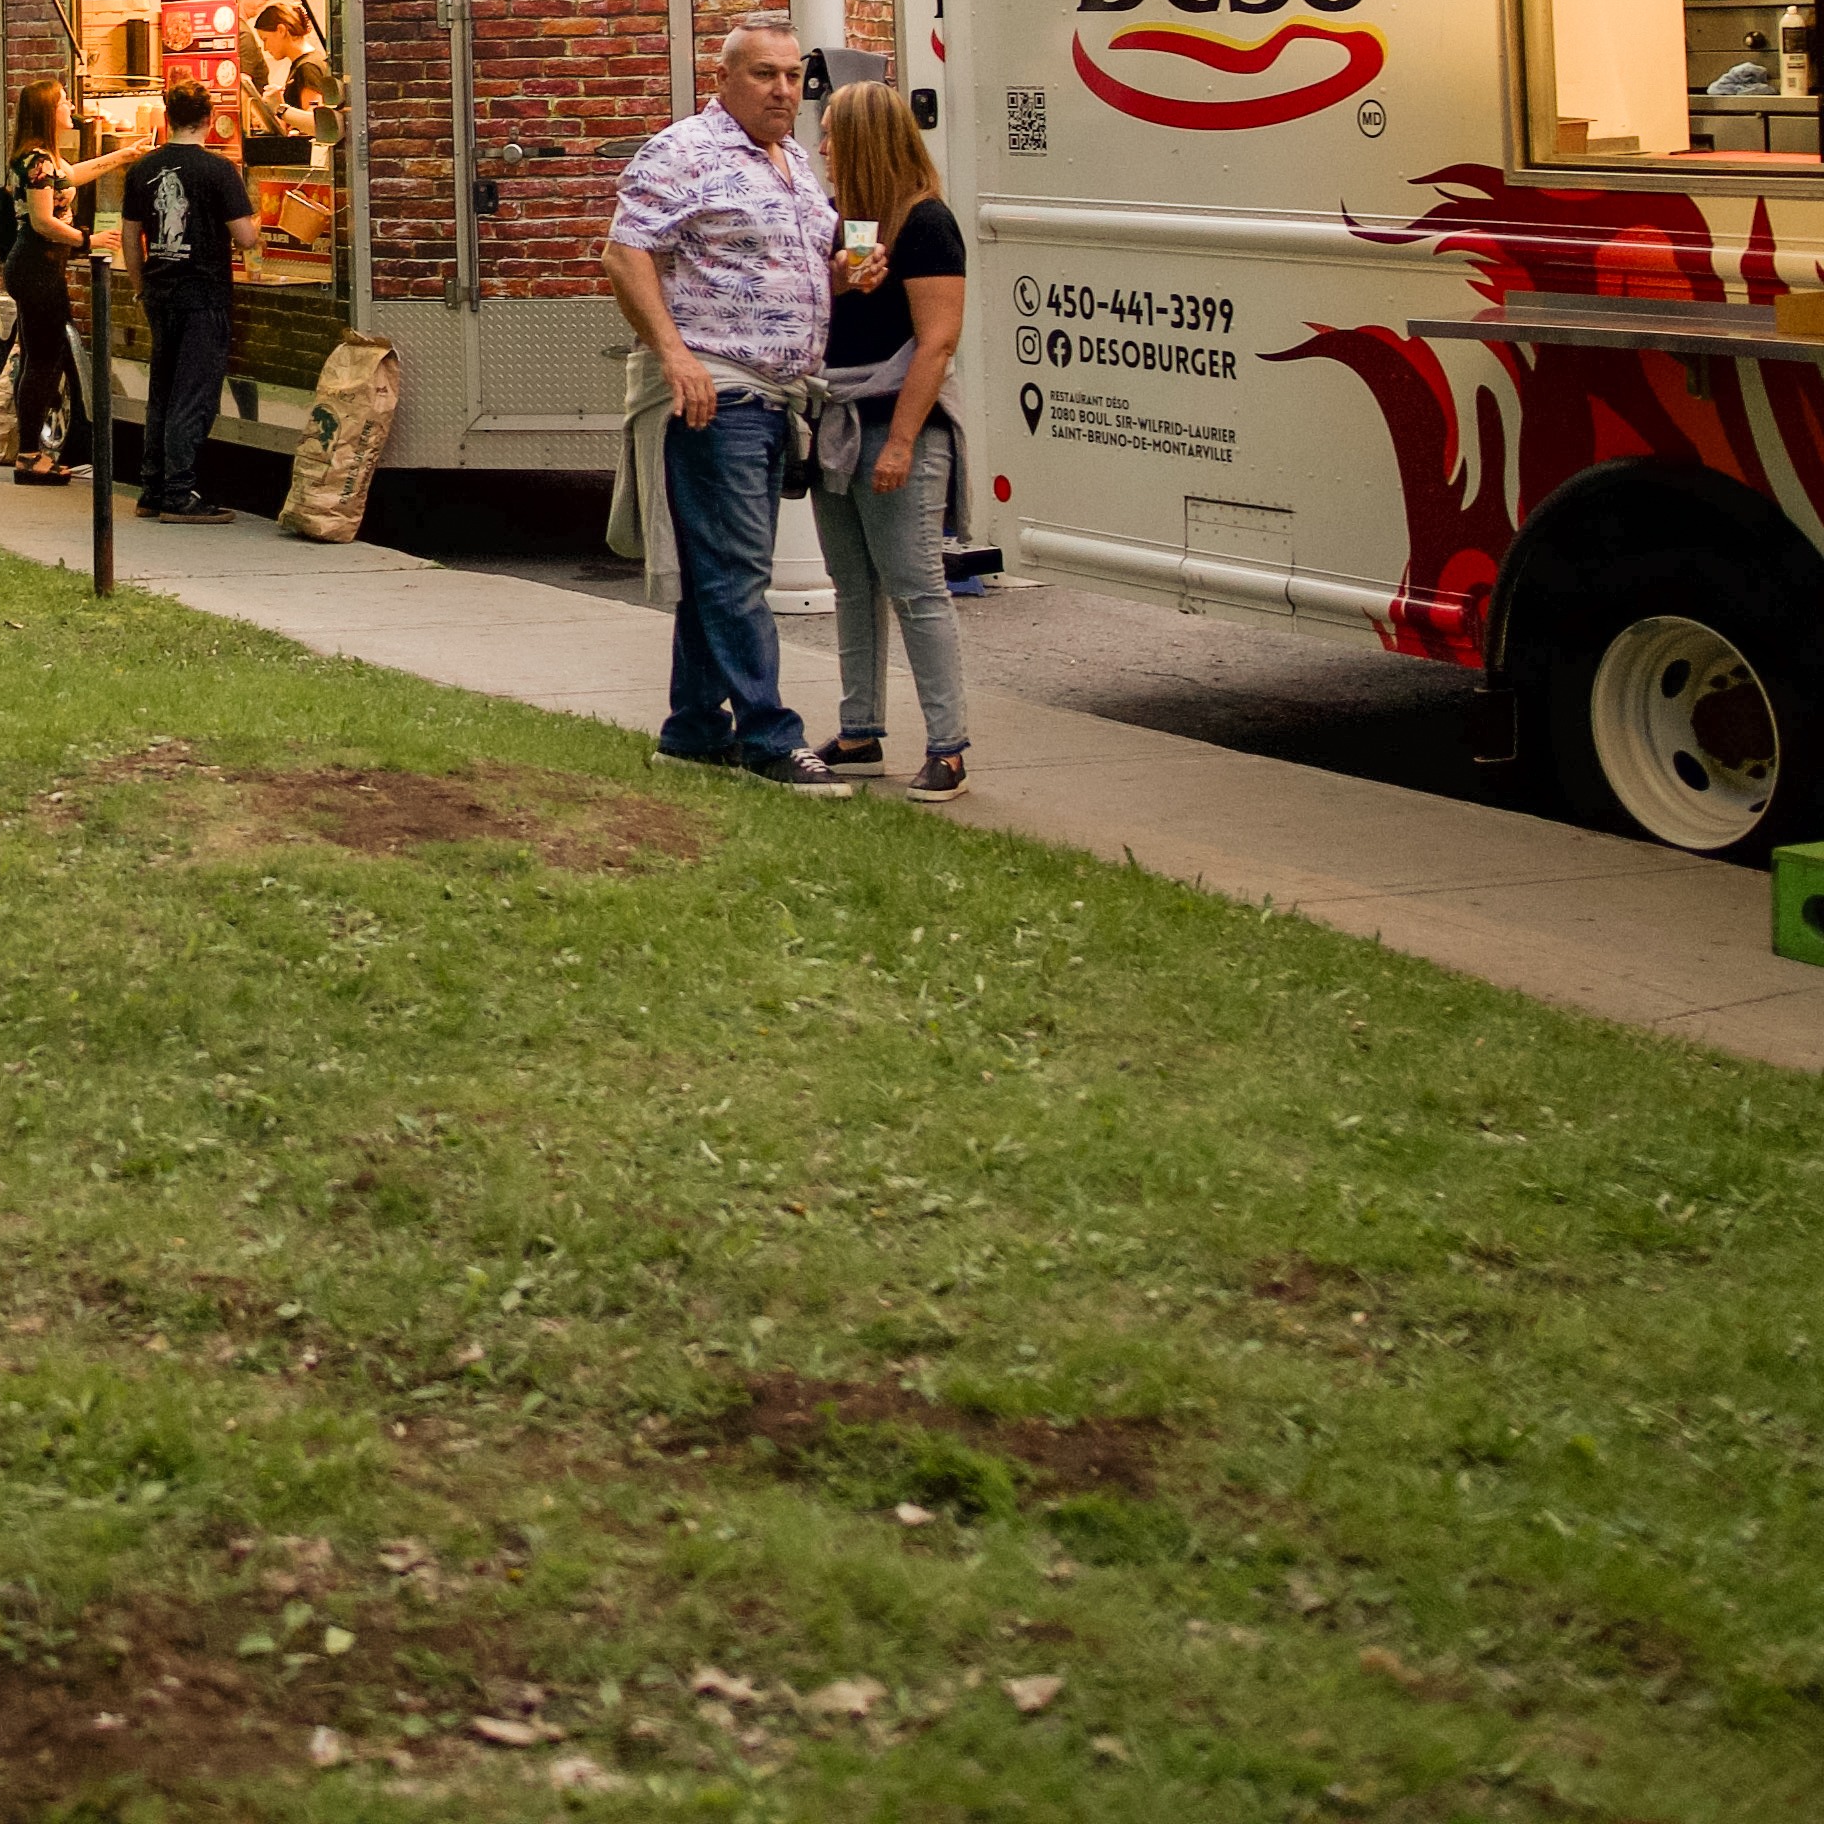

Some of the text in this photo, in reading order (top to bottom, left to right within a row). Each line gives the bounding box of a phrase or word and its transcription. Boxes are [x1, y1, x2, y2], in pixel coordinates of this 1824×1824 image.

[1362, 112, 1382, 125] MD
[1046, 283, 1234, 333] 450-441-3399
[1079, 335, 1237, 380] DESOBURGER
[1050, 390, 1129, 410] RESTAURANT DÉSO
[1050, 406, 1076, 422] 2080
[1115, 414, 1236, 444] SIR-WILFRID-LAURIER
[1051, 425, 1233, 463] SAINT-BRUNO-DE-MONTARVILLE
